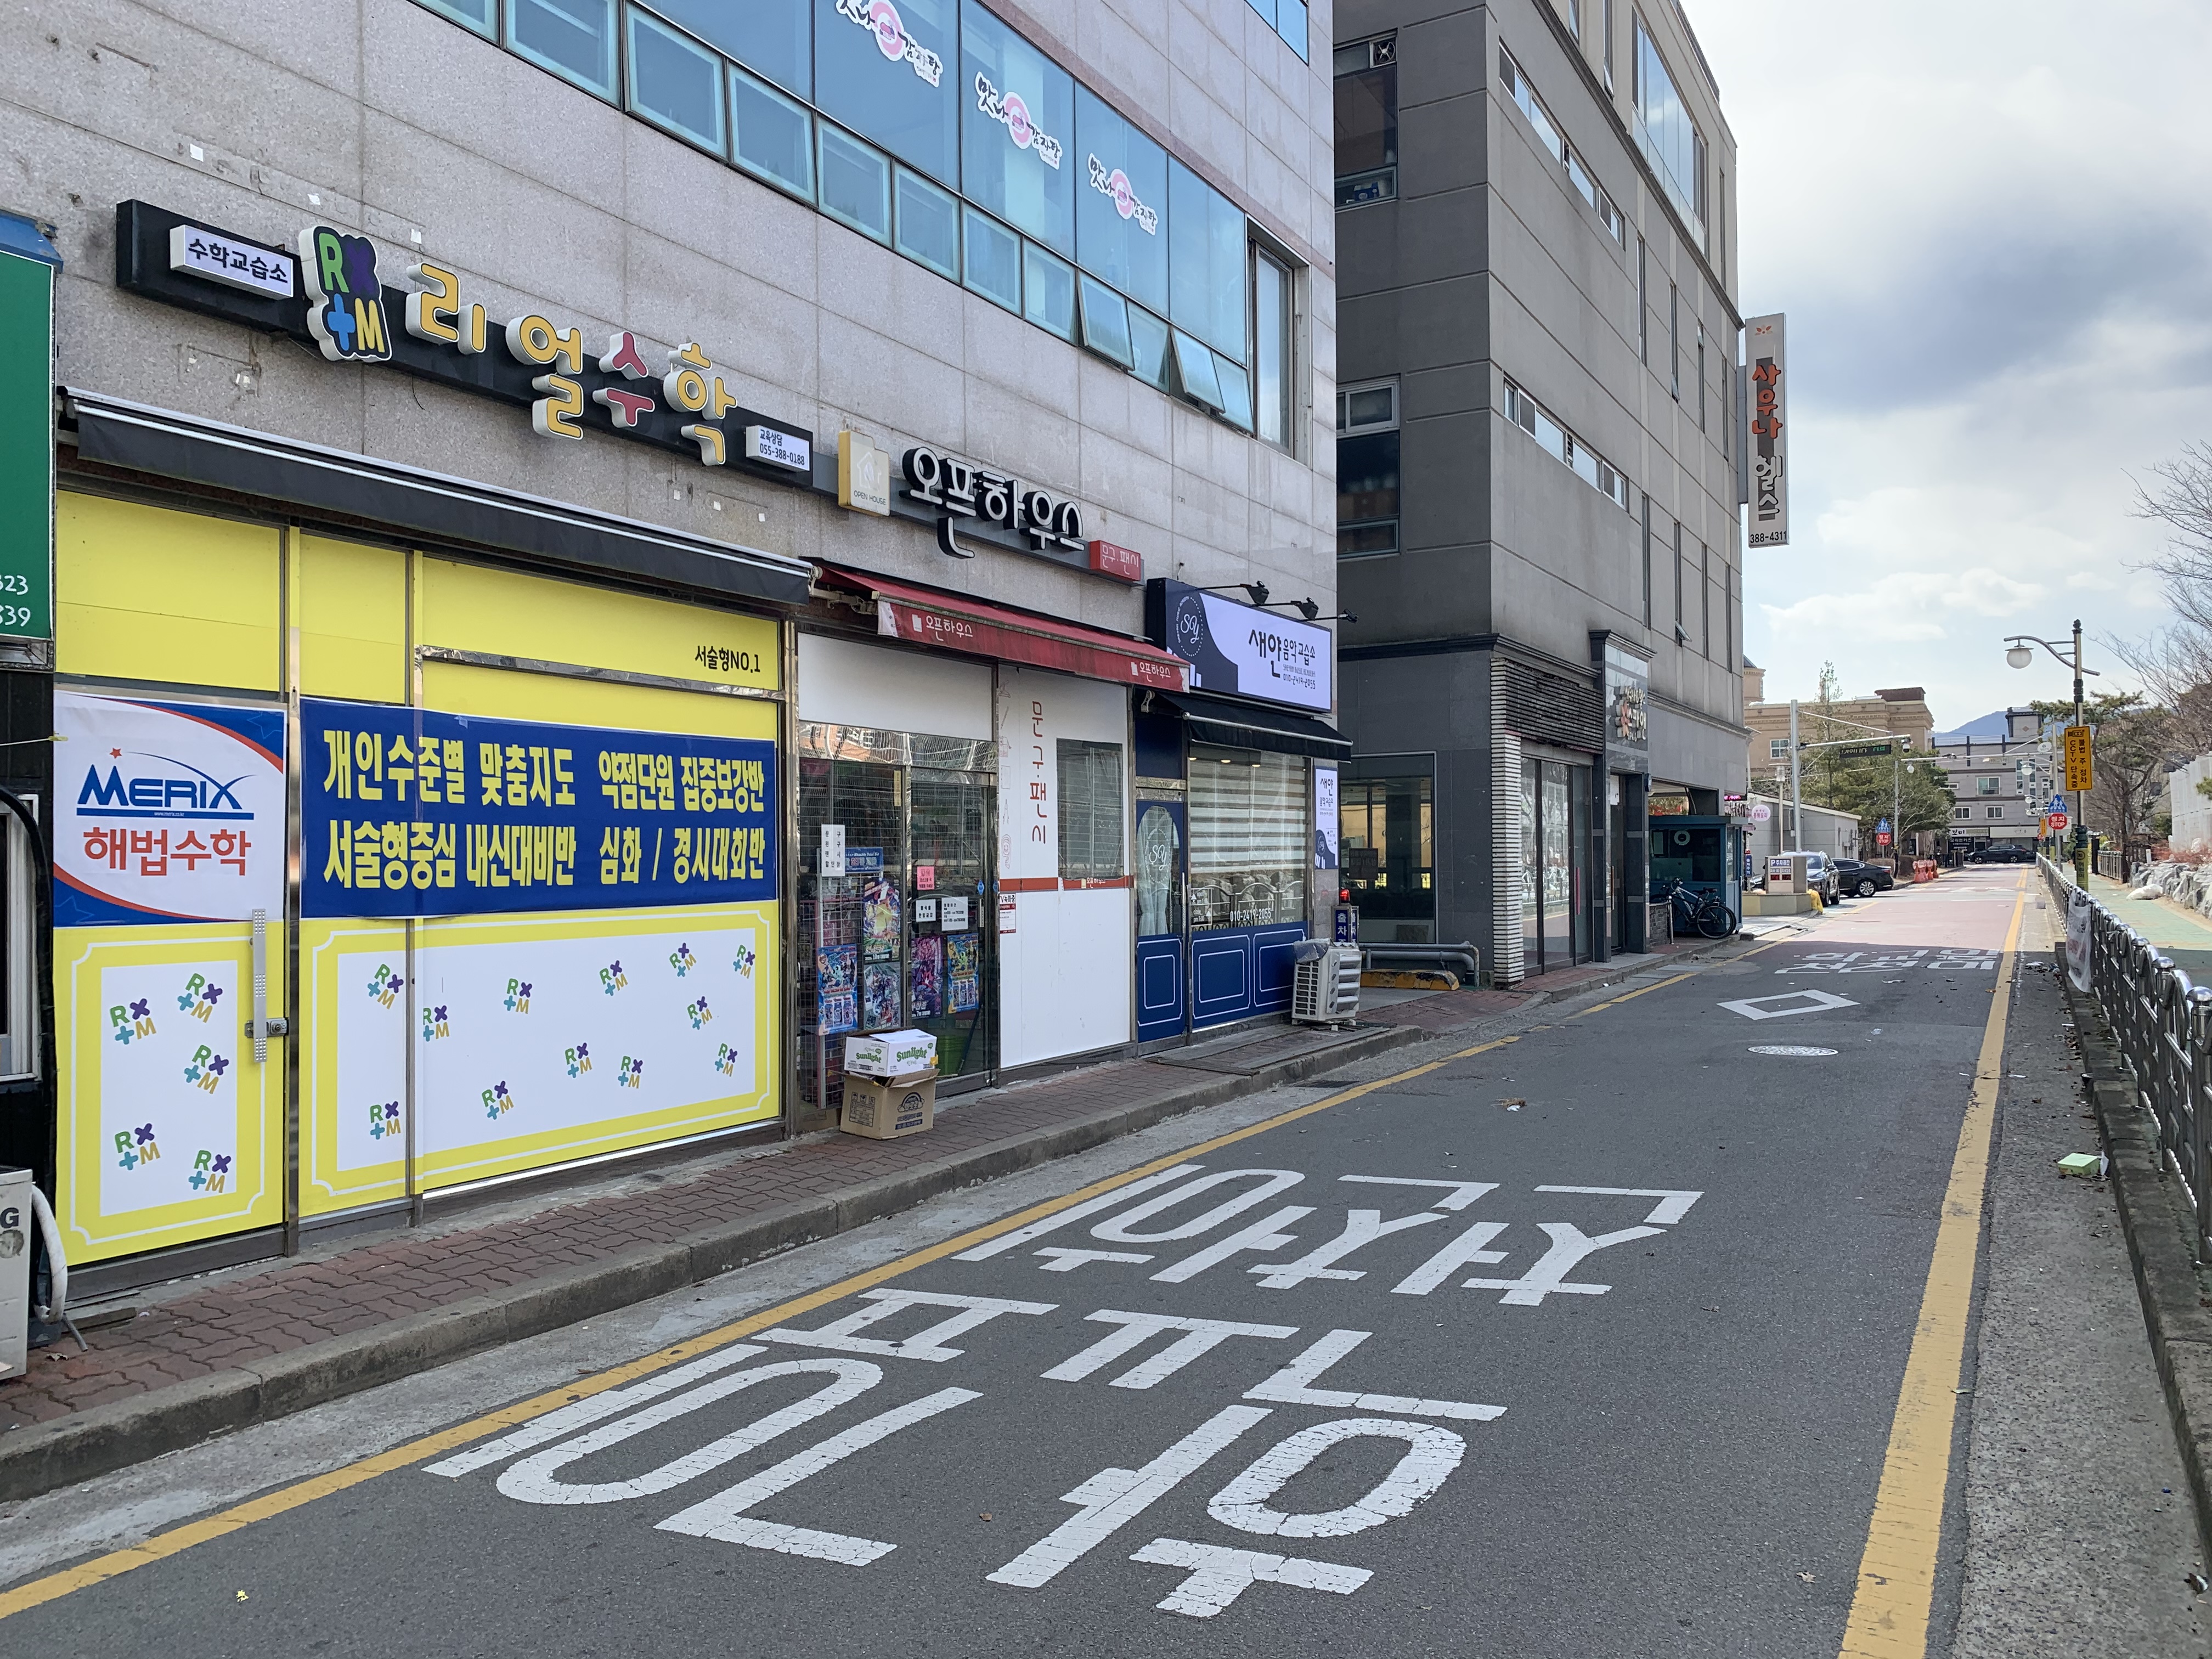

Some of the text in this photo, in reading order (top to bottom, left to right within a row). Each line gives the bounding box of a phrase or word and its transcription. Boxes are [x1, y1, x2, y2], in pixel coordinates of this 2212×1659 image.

[1026, 121, 1060, 159] 감자탕
[188, 237, 289, 285] 수학교습소
[410, 262, 738, 466] 리얼수학
[1752, 363, 1783, 439] 사우나
[759, 429, 783, 447] 교육상담
[759, 444, 805, 466] 055-388-0188
[853, 490, 886, 506] OPEN HOUSE
[900, 447, 1085, 558] 오픈하우스
[1754, 454, 1783, 516] 헬스
[1750, 531, 1787, 544] 388-4311
[926, 614, 973, 641] 오픈하우스
[1139, 662, 1171, 682] 오픈하우스
[1249, 629, 1282, 678] 새얀
[77, 764, 250, 810] MERIX
[323, 729, 765, 814] 개인수준별 맞춤지도 약점단원 집중보강반
[82, 827, 251, 876] 해법수학
[323, 819, 456, 890] 서술형중심
[466, 823, 577, 888] 내신대비반
[599, 826, 641, 886] 심화
[673, 827, 766, 885] 경시대회반
[1230, 908, 1272, 922] 010-2419-2055
[856, 1052, 882, 1063] Sunlight
[896, 1047, 927, 1062] Sunlight
[951, 1163, 1705, 1306] 천천히
[421, 1287, 1510, 1618] 학교앞
